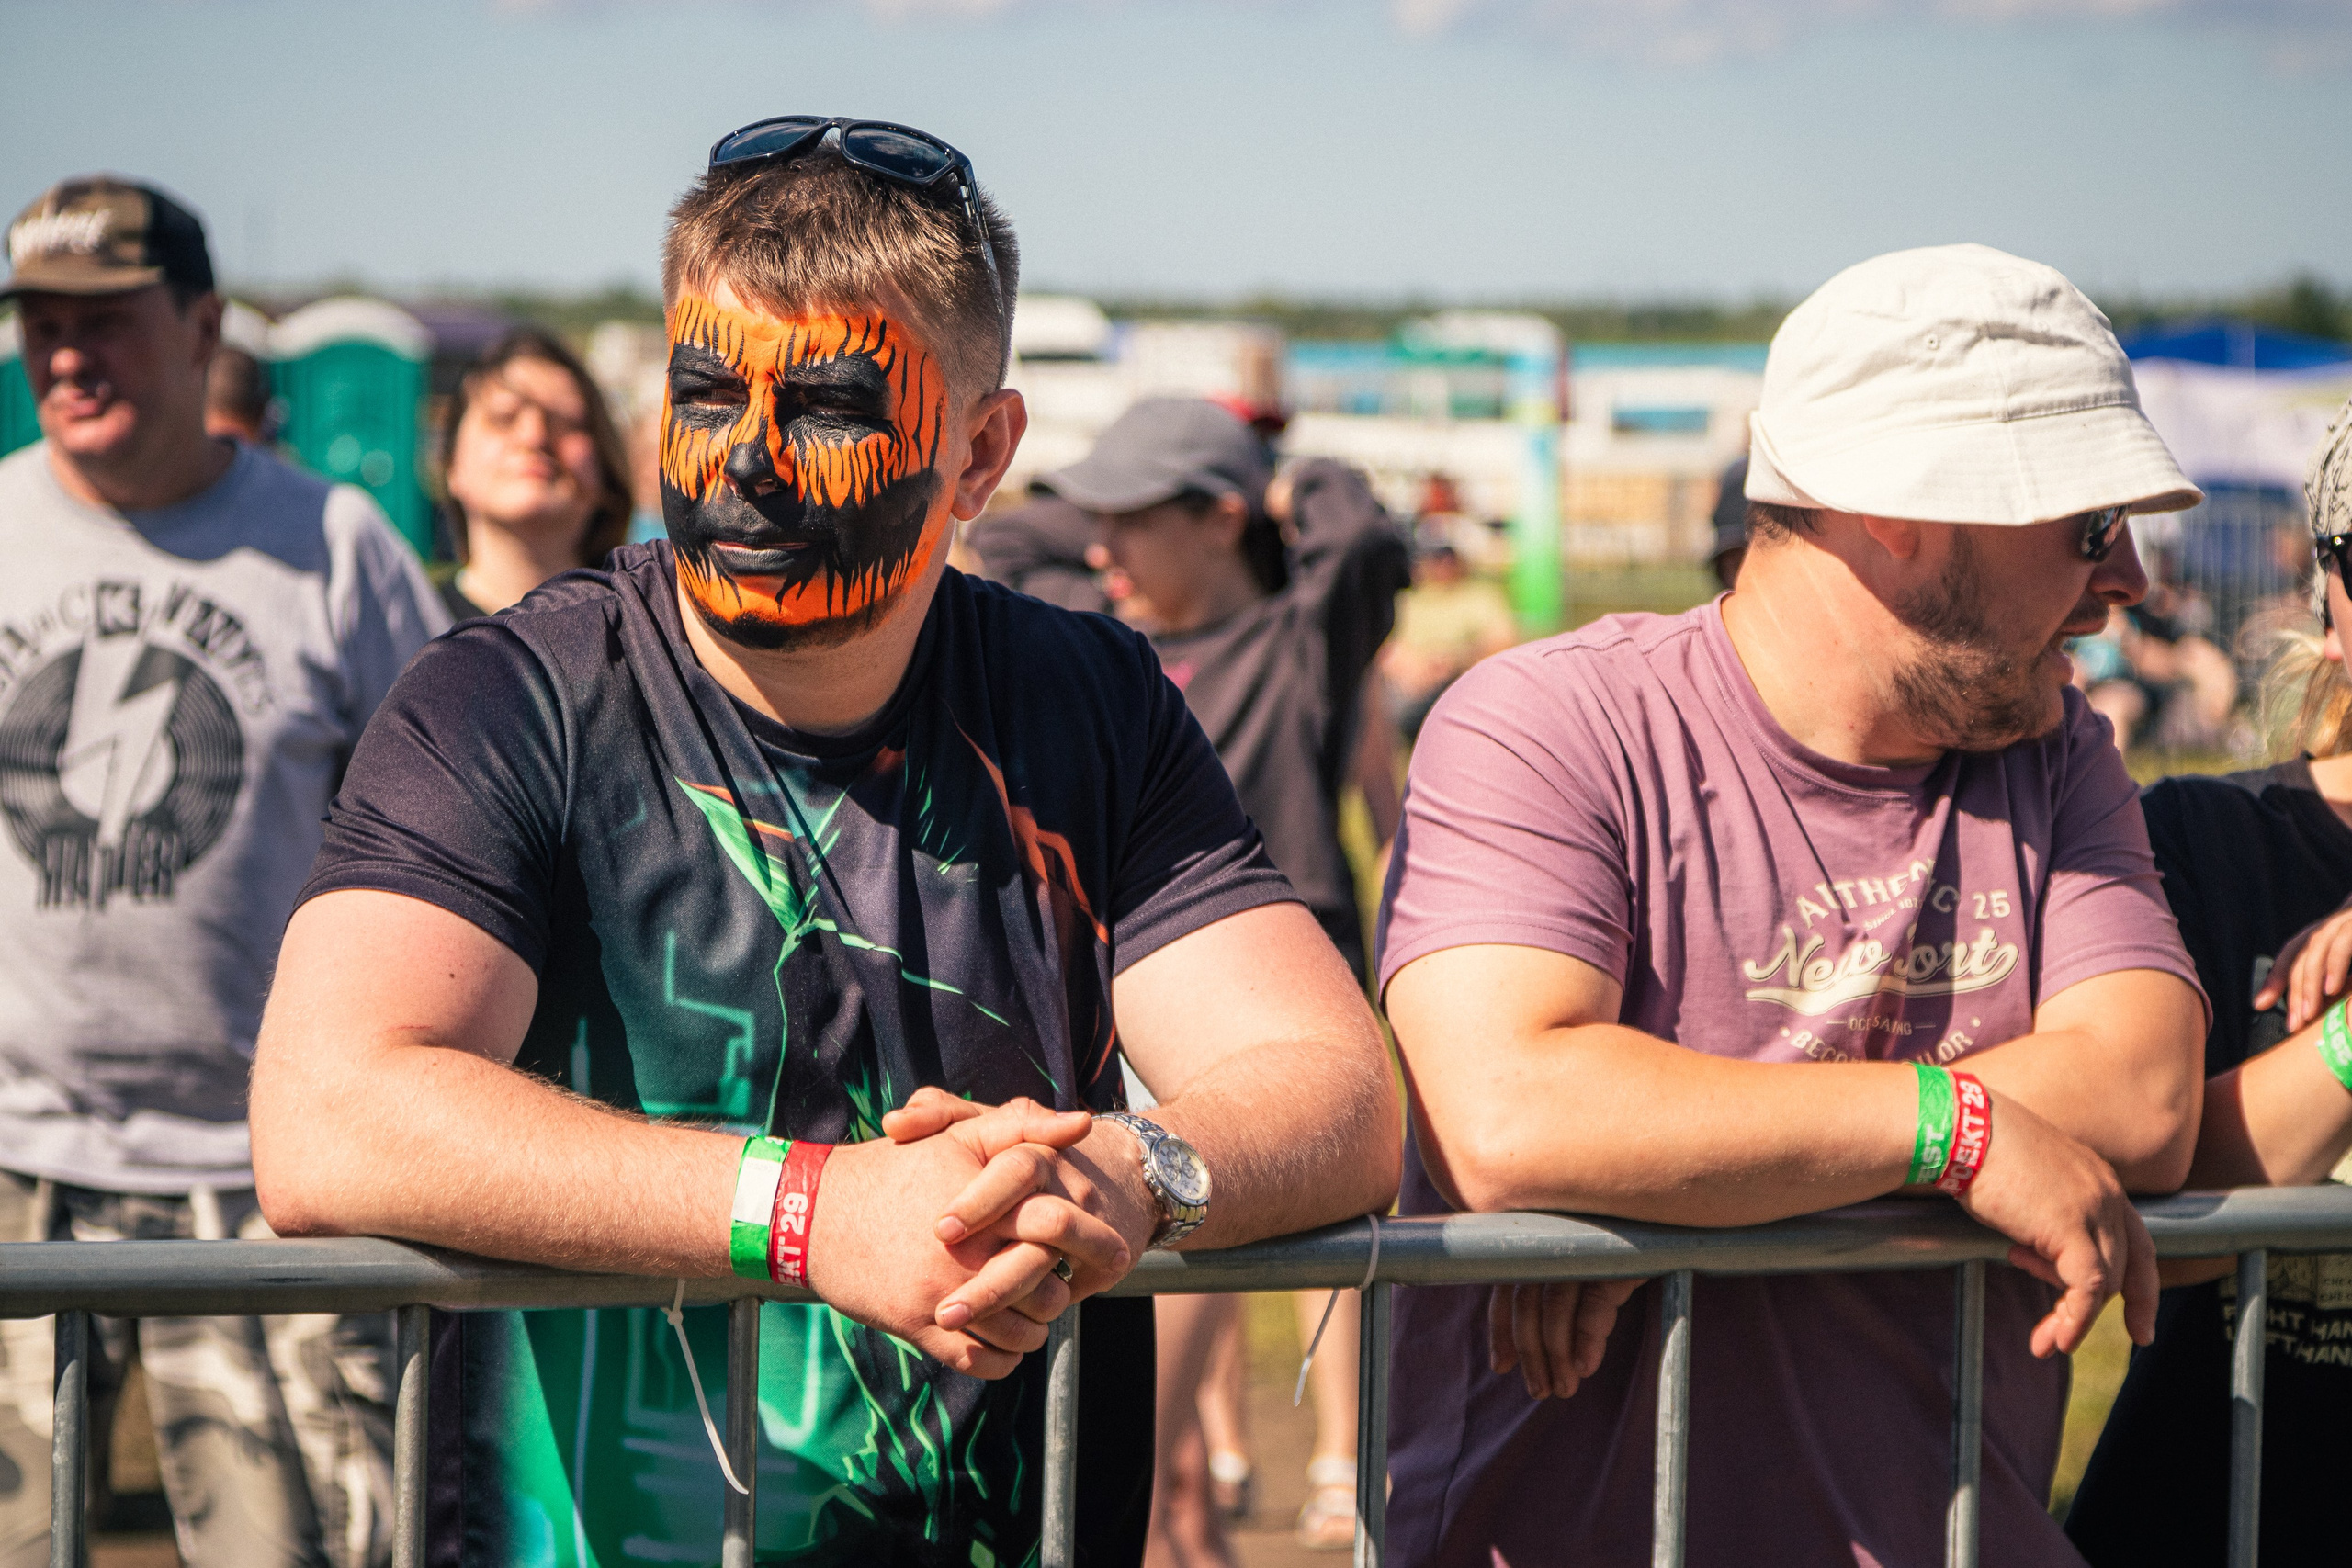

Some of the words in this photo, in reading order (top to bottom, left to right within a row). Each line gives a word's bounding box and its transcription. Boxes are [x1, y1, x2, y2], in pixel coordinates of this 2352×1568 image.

[1974, 889, 2011, 919] 25
[1745, 925, 2018, 994] Newort
[1959, 1080, 1985, 1109] 29
[781, 1192, 808, 1235] 29
